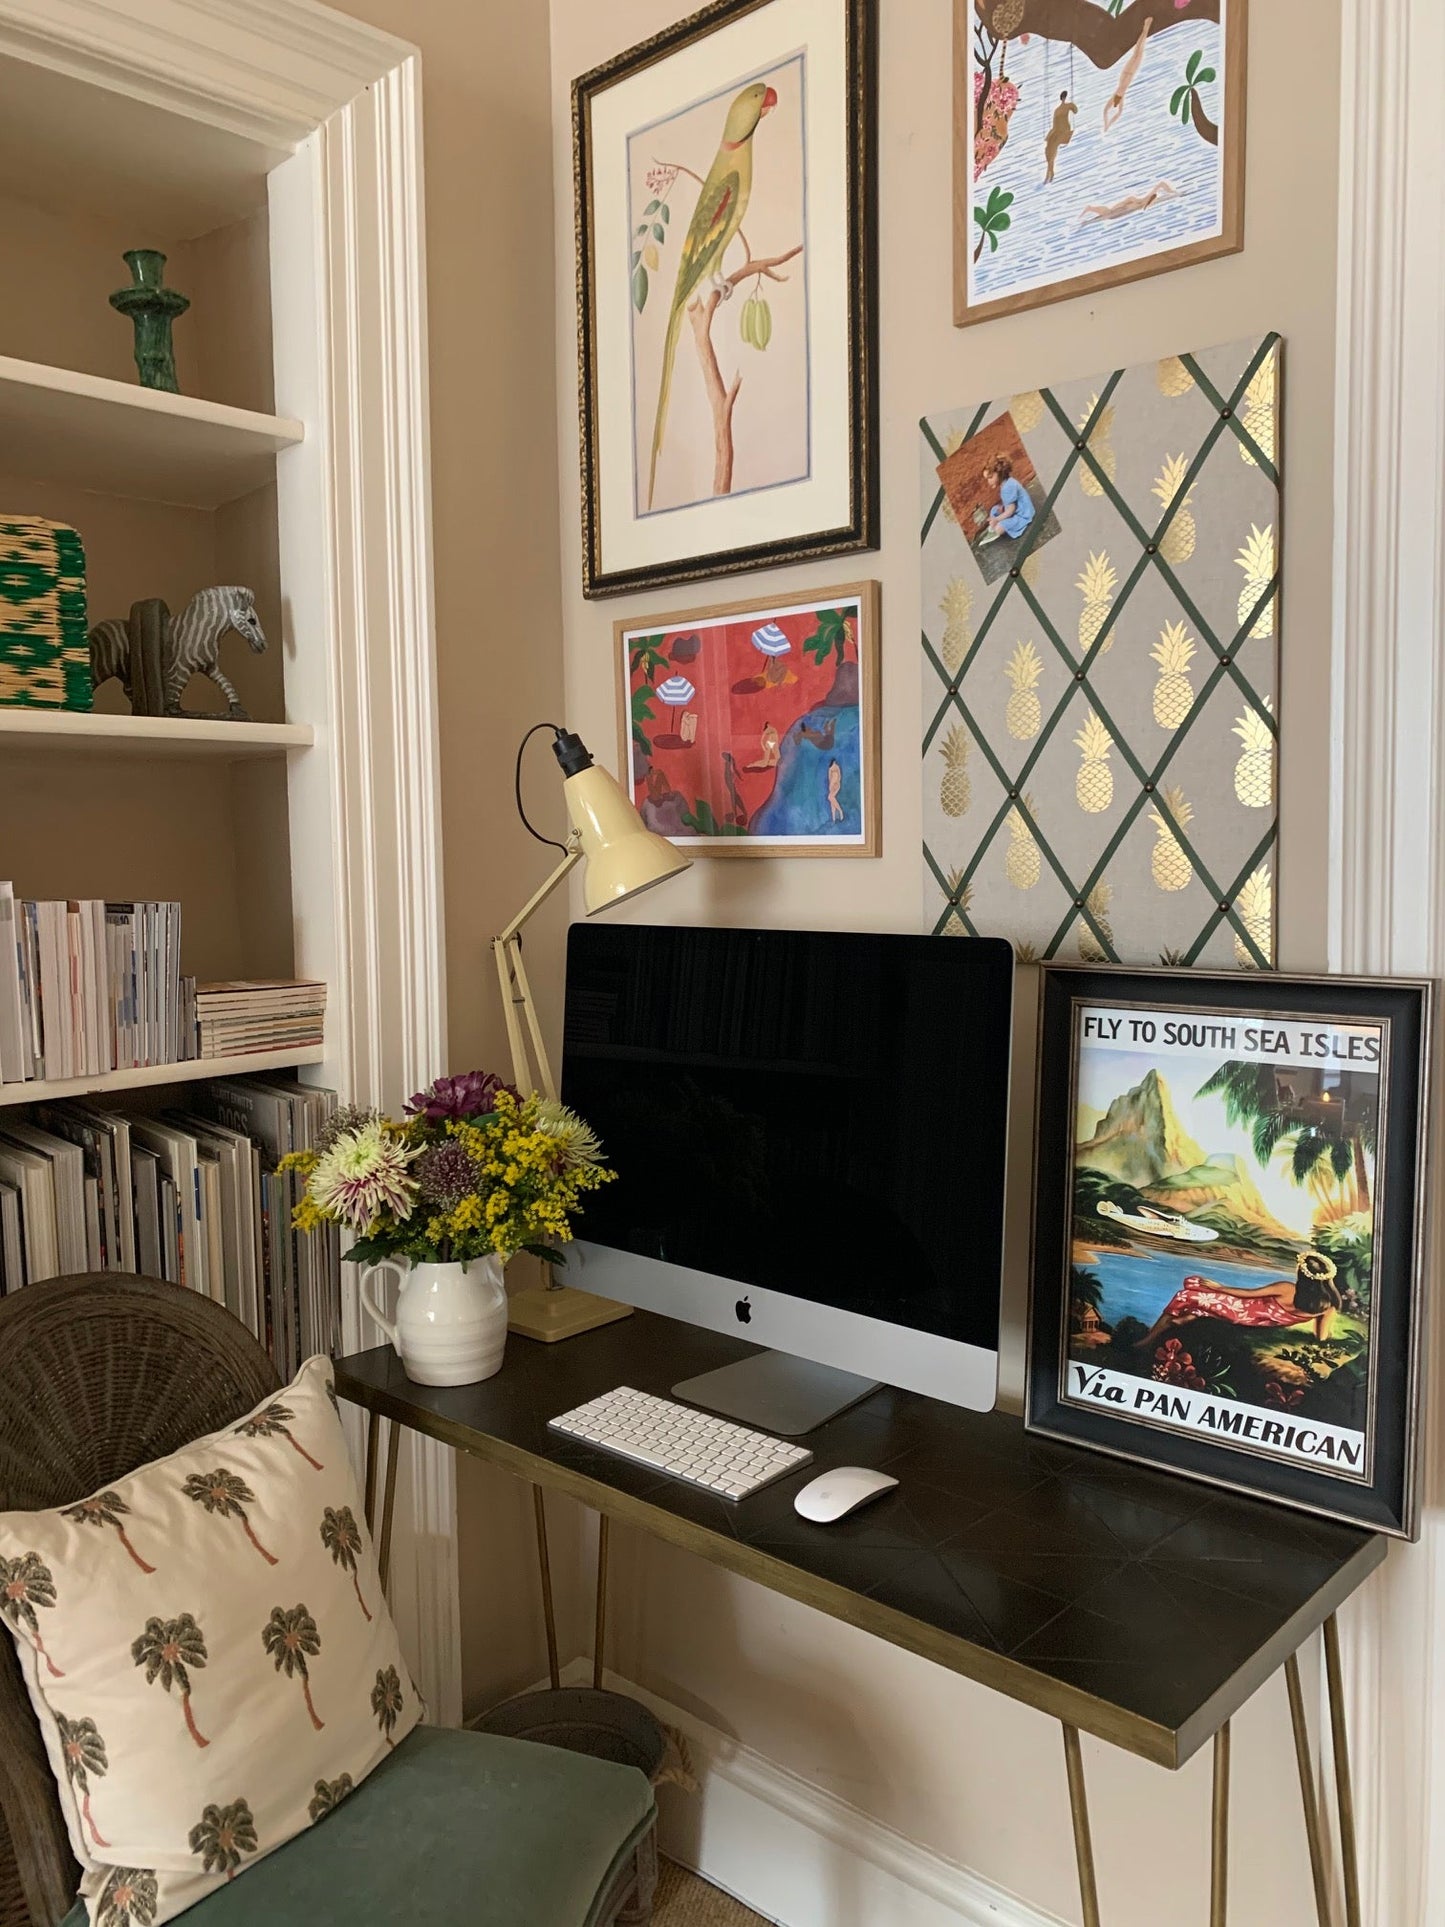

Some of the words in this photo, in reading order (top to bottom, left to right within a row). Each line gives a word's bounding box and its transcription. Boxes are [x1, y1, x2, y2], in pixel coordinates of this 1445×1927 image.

[1084, 1016, 1123, 1040] FLY
[1128, 1019, 1157, 1043] TO
[1162, 1022, 1236, 1050] SOUTH
[1243, 1028, 1291, 1055] SEA
[1299, 1032, 1380, 1063] ISLES
[1075, 1365, 1127, 1403] Via
[1134, 1388, 1192, 1421] PAN
[1197, 1405, 1362, 1466] AMERICAN
